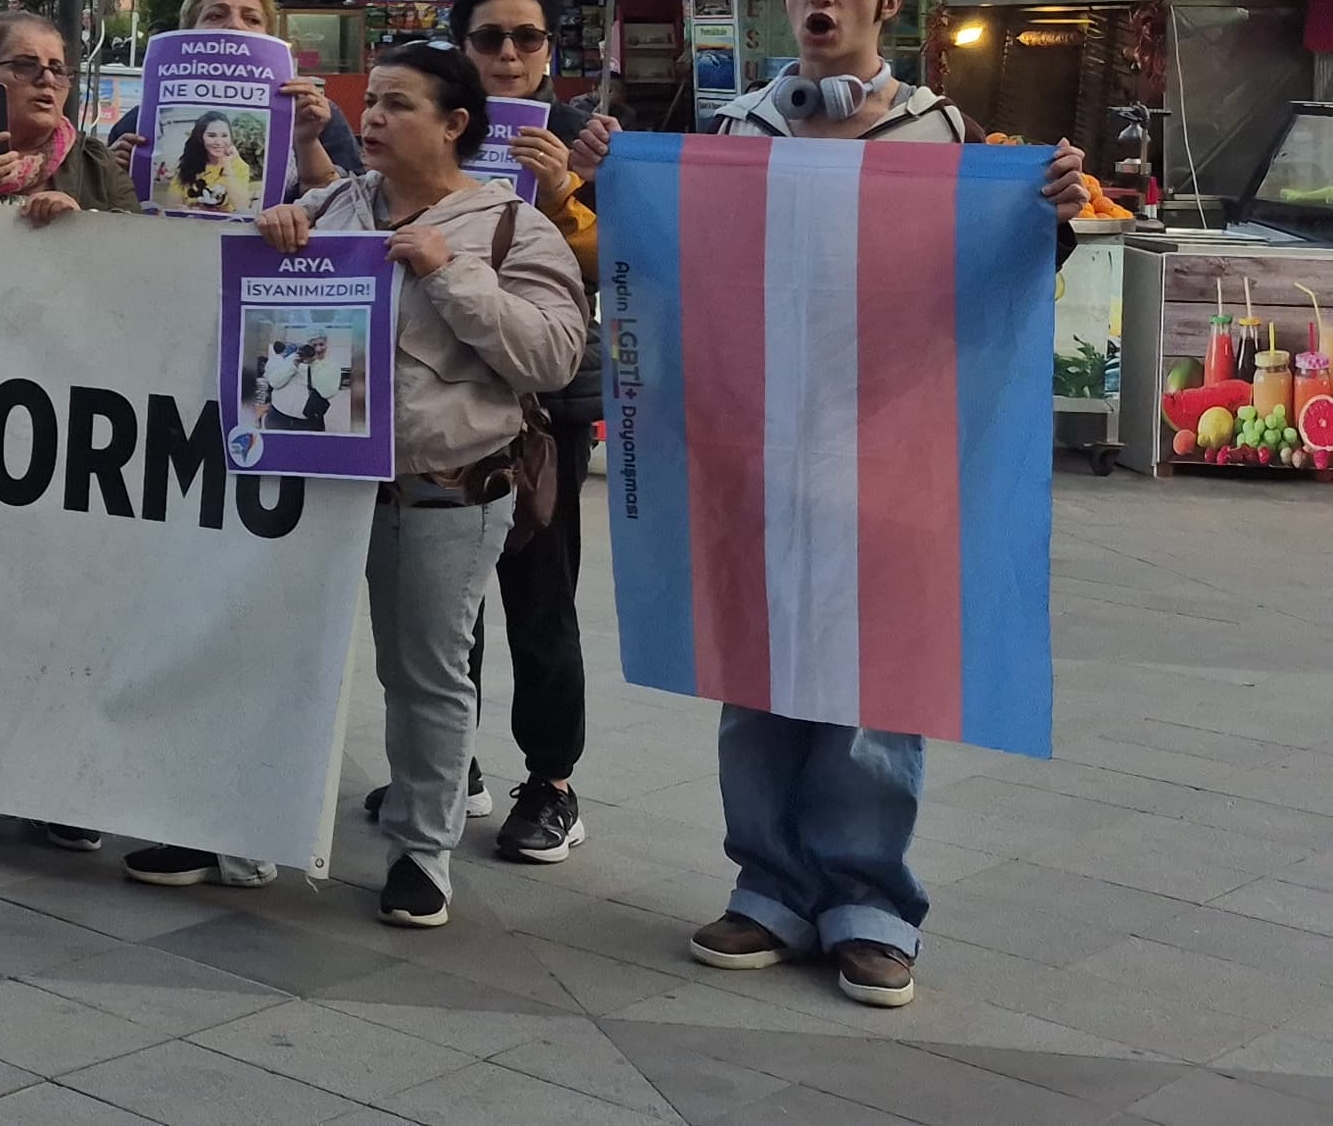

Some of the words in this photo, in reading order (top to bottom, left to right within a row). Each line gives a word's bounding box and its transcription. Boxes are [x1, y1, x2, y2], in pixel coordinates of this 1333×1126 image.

[181, 39, 251, 56] NADİRA
[158, 59, 275, 80] KADİROVA'YA
[163, 84, 189, 98] NE
[194, 84, 266, 101] OLDU?
[278, 257, 335, 273] ARYA
[247, 280, 371, 296] İSYANIMIZDIR!
[612, 260, 630, 312] Aydın
[621, 404, 639, 520] Dayanışması
